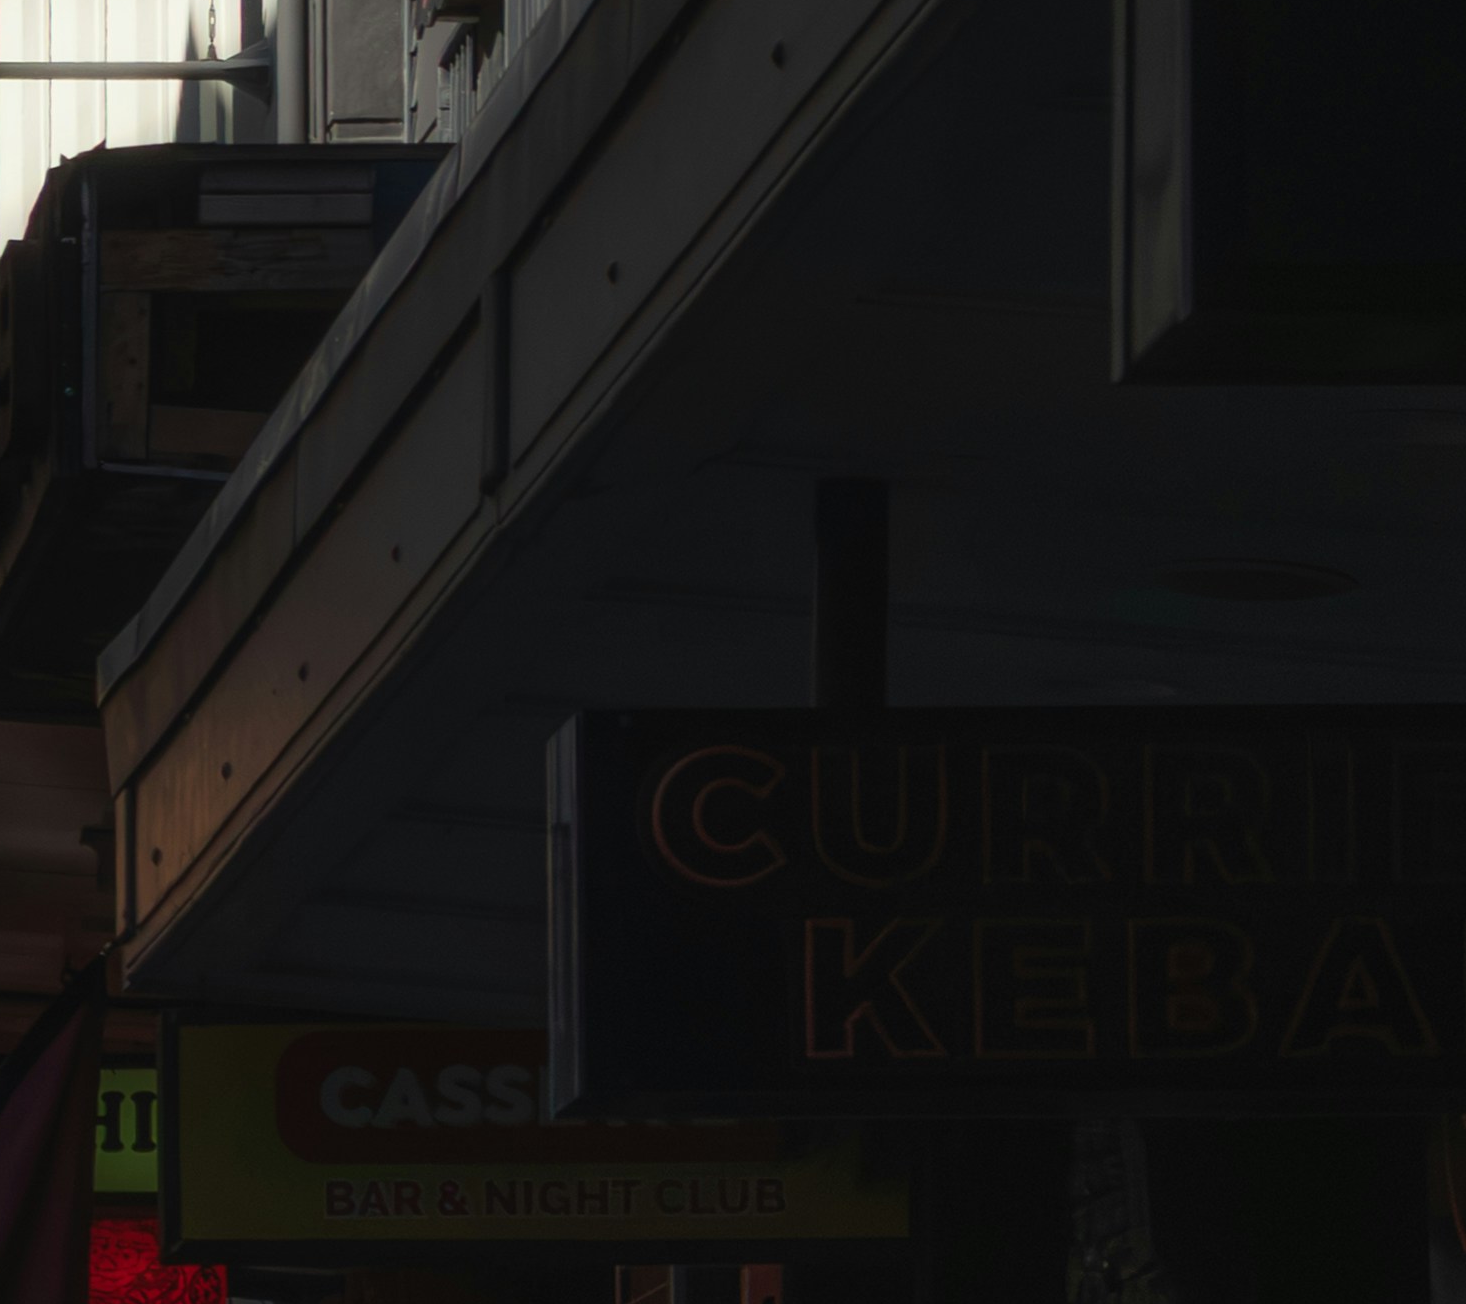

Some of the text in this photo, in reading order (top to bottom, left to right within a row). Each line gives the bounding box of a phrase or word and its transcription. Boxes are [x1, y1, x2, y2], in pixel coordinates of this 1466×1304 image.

[324, 1179, 788, 1218] BAR & NIGHT CLUB
